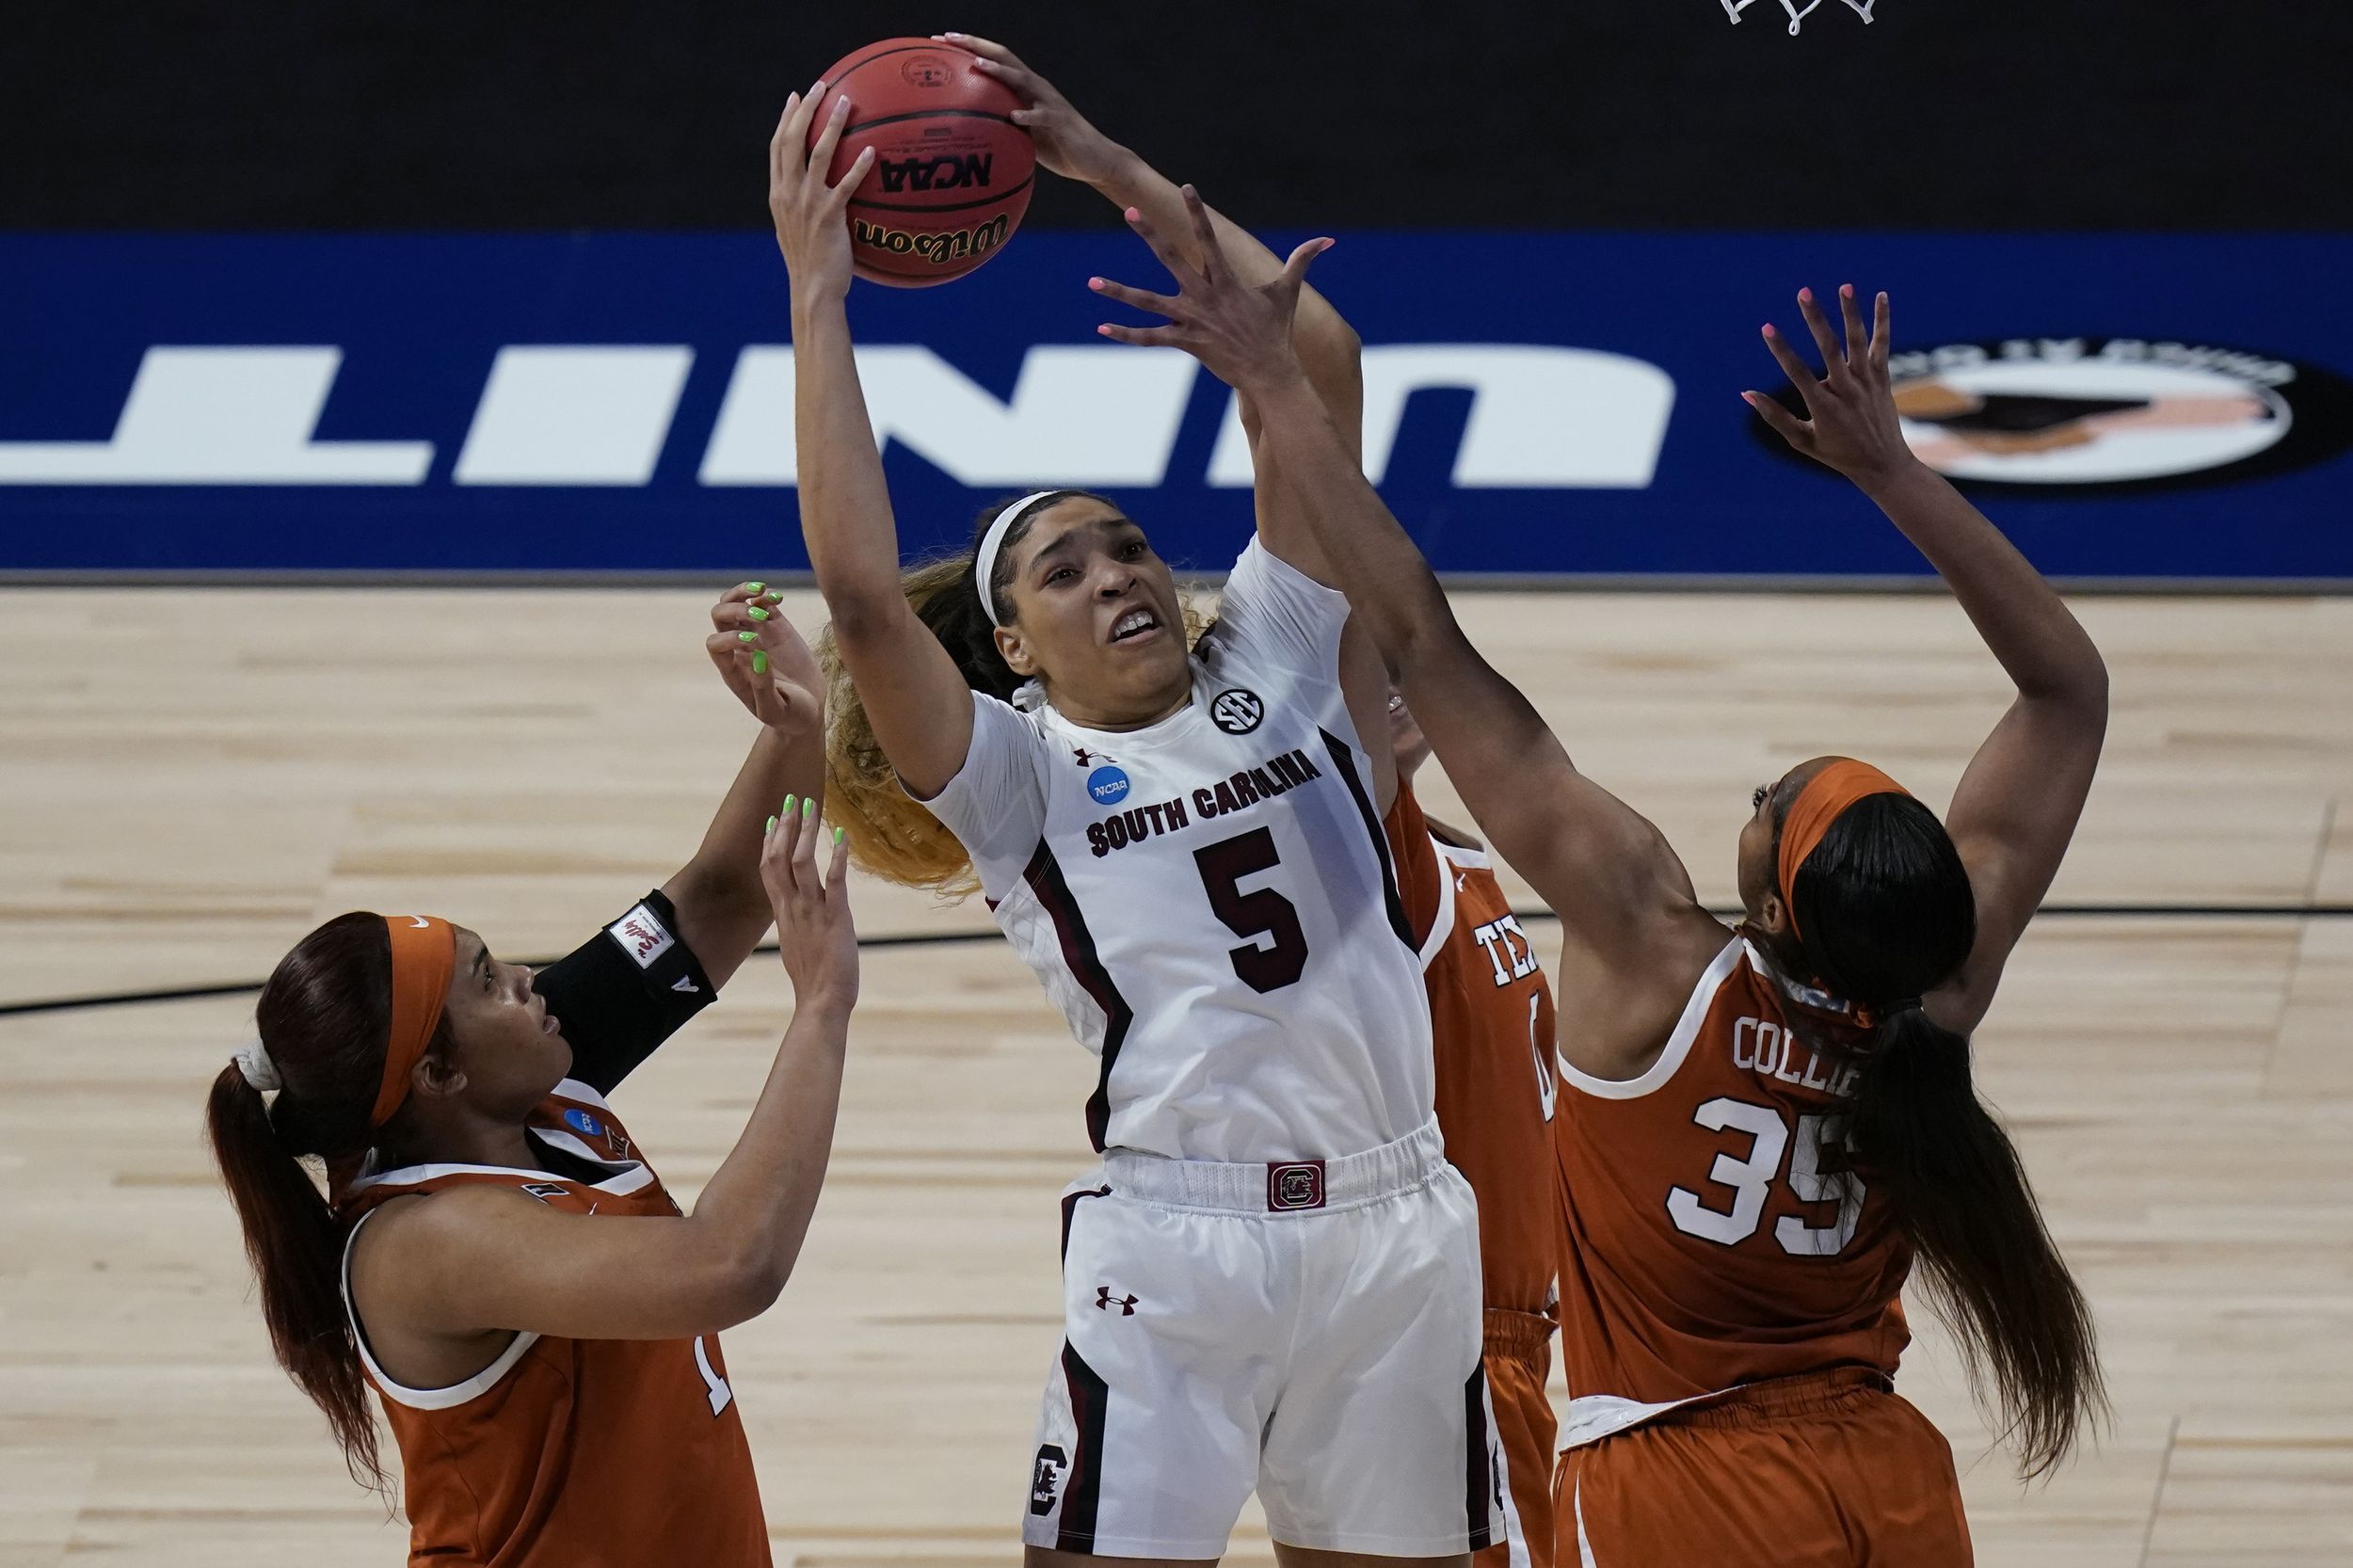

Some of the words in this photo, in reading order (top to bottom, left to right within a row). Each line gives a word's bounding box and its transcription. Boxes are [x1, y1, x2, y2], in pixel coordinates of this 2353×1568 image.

[881, 153, 992, 193] NCAA
[855, 213, 1010, 264] Wilson
[1214, 690, 1261, 732] SEC
[1086, 797, 1190, 858] SOUTH
[1192, 748, 1322, 820] CAROLINA
[1094, 779, 1128, 797] NCAA
[1192, 825, 1309, 994] 5
[1666, 1096, 1867, 1256] 35
